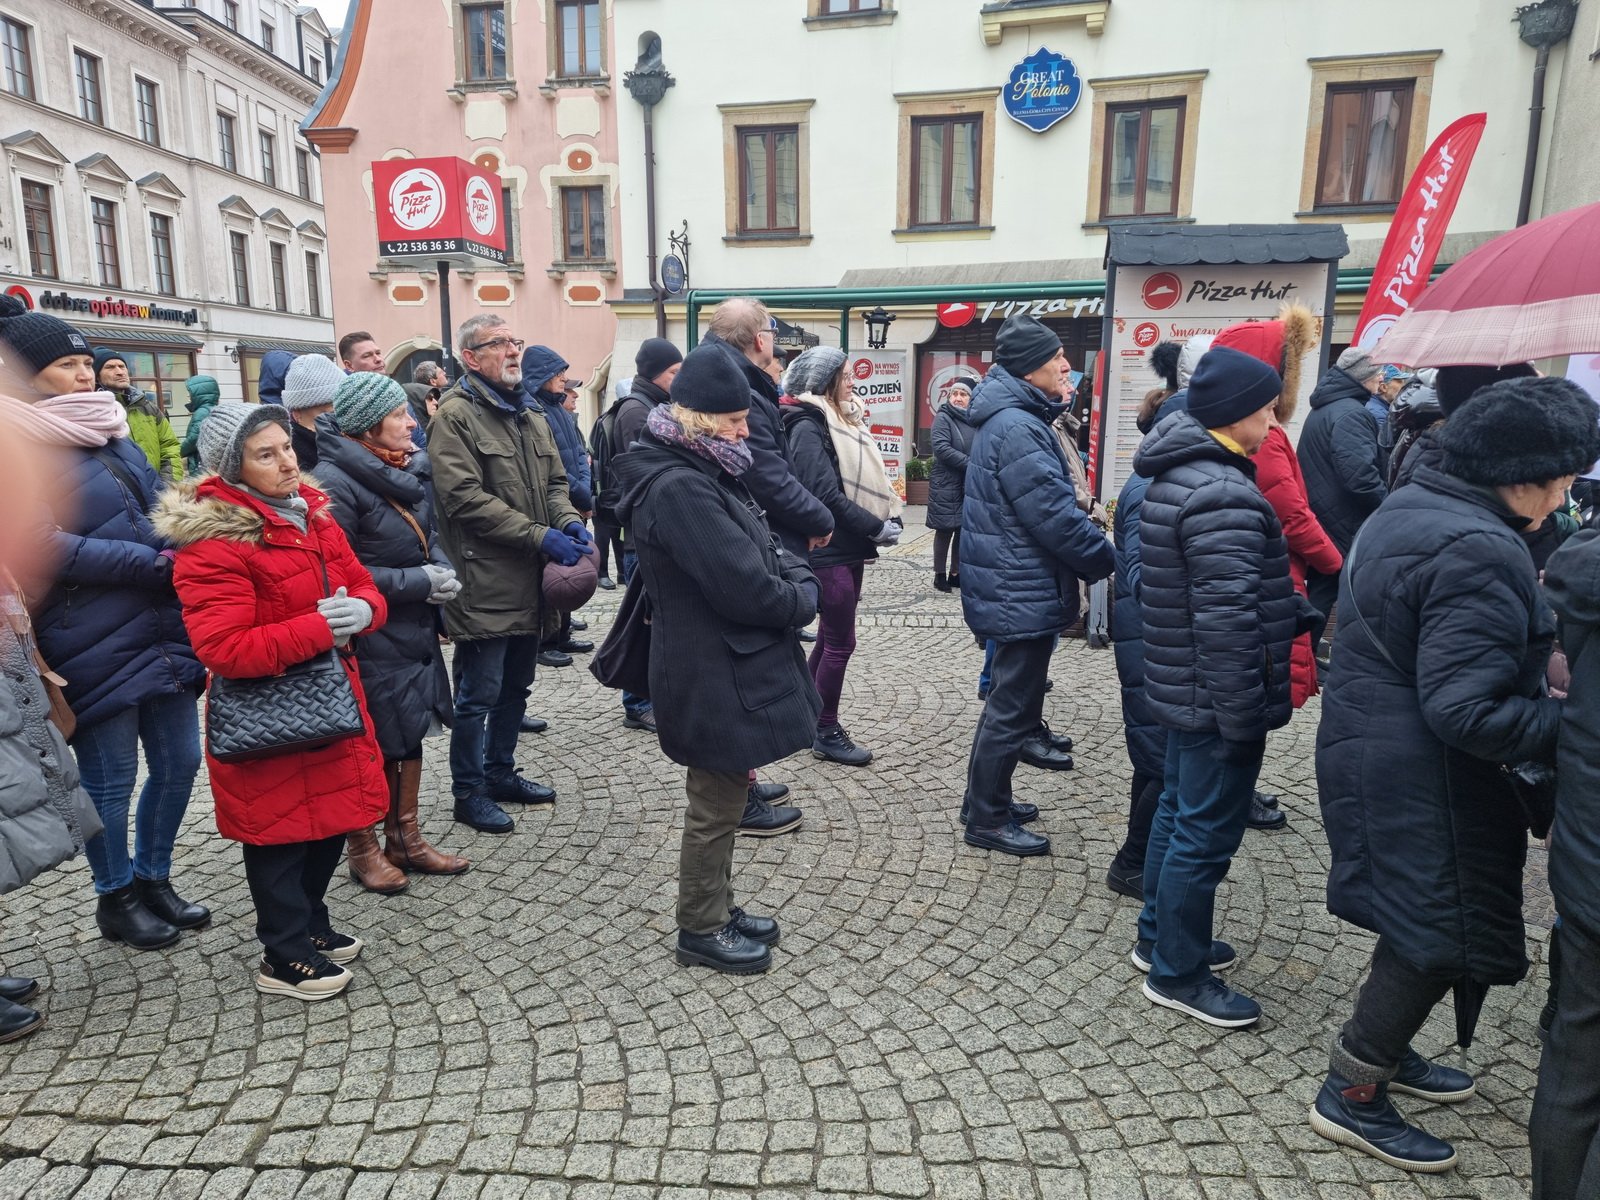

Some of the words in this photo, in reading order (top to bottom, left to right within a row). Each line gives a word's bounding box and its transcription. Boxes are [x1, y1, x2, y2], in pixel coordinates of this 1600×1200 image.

[1020, 70, 1064, 84] GREAT
[1012, 79, 1071, 100] Polonia
[1420, 138, 1454, 211] Hut
[401, 194, 432, 211] Pizza
[472, 200, 489, 213] Pizza
[407, 204, 430, 220] Hut
[476, 213, 488, 223] Hut
[397, 243, 408, 252] 22
[411, 242, 428, 251] 536
[430, 241, 442, 251] 36
[444, 241, 456, 250] 36
[472, 243, 479, 254] 22
[480, 245, 489, 257] 536
[490, 249, 497, 259] 36
[497, 251, 504, 261] 36
[1186, 280, 1248, 303] Pizza
[1250, 280, 1298, 301] Hut
[39, 290, 198, 326] dobraopiekawdomu.pl
[870, 380, 902, 396] DZIEŃ
[878, 395, 902, 404] OKAZJE
[883, 442, 889, 452] 1
